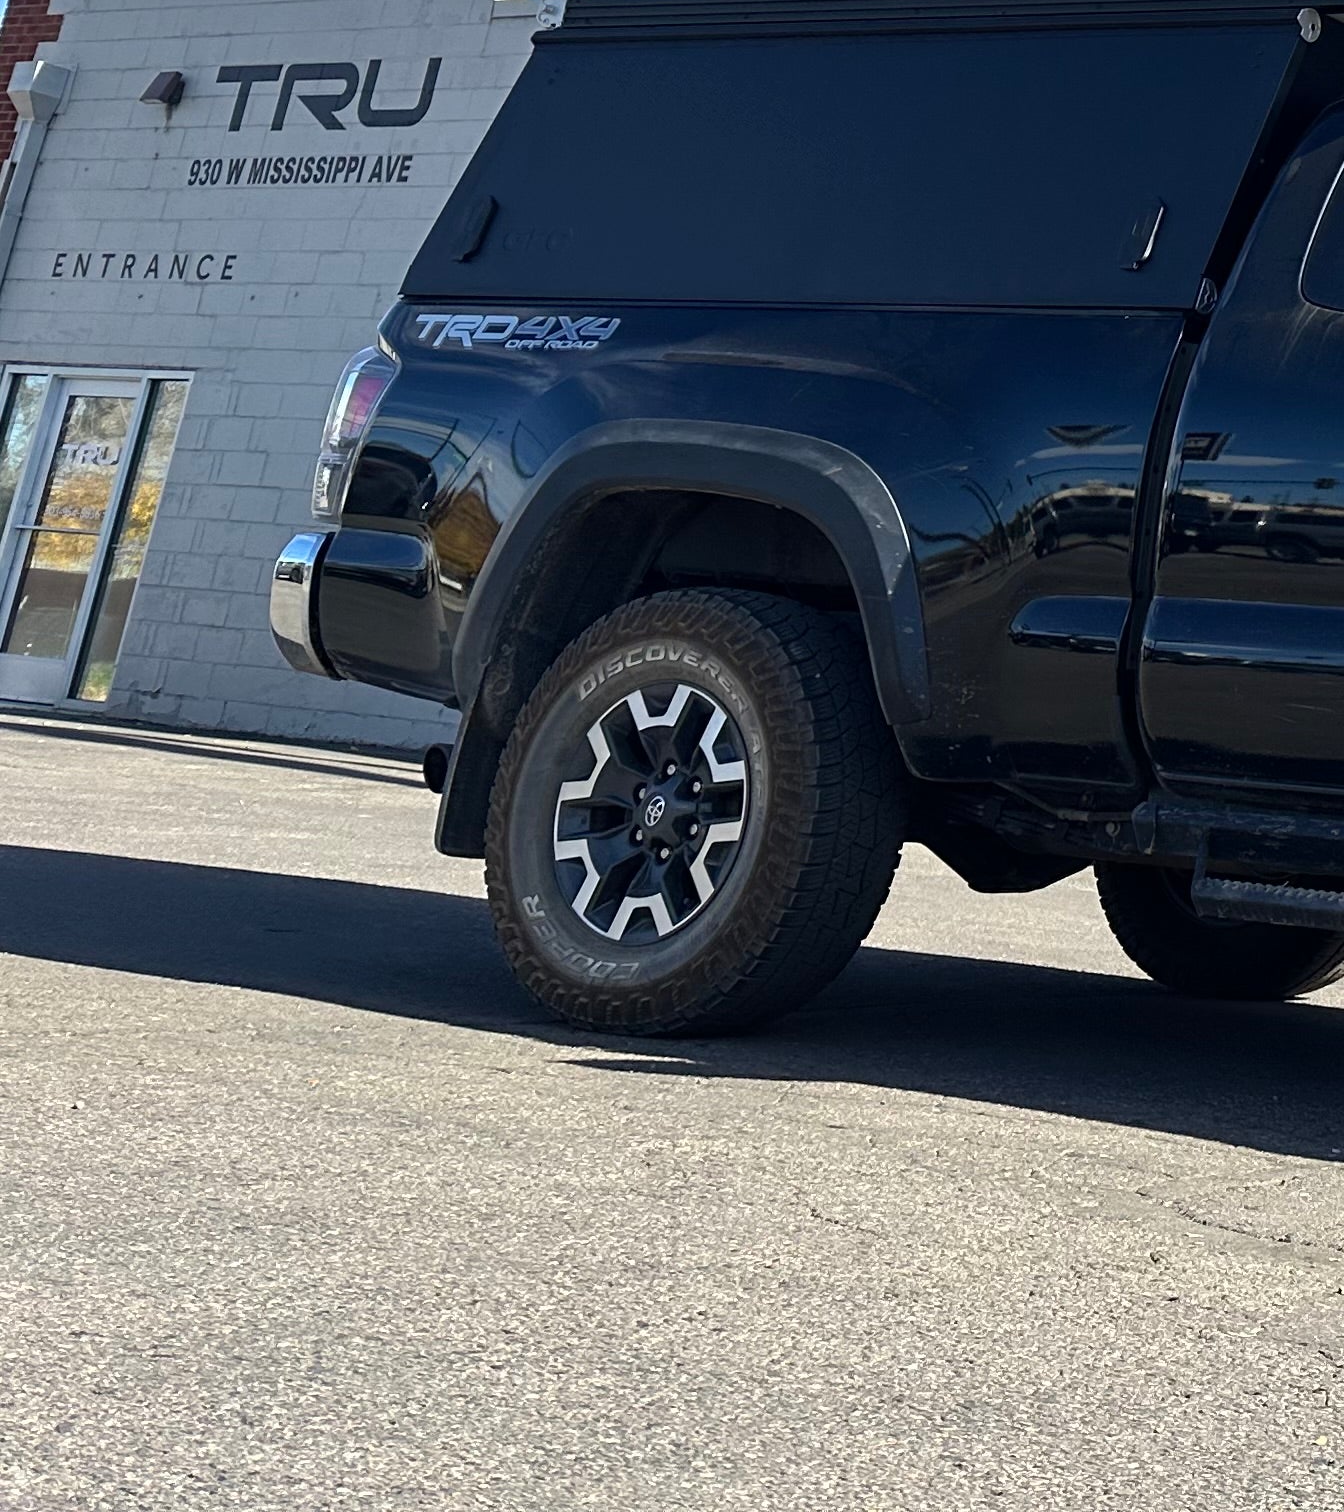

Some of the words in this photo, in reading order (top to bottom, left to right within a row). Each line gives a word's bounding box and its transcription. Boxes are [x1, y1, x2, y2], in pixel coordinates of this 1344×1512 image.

[216, 57, 442, 131] TRU
[187, 158, 222, 186] 930
[225, 157, 247, 185] W
[247, 155, 367, 184] MISSISSIPPI
[368, 154, 413, 183] AVE
[51, 253, 238, 280] ENTRANCE
[415, 313, 520, 349] TRD
[514, 315, 622, 341] 4X4
[504, 339, 546, 349] OFF
[544, 340, 600, 350] ROAD
[61, 443, 122, 466] TRU
[578, 644, 750, 714] DISCOVERER
[521, 893, 640, 982] COOPER
